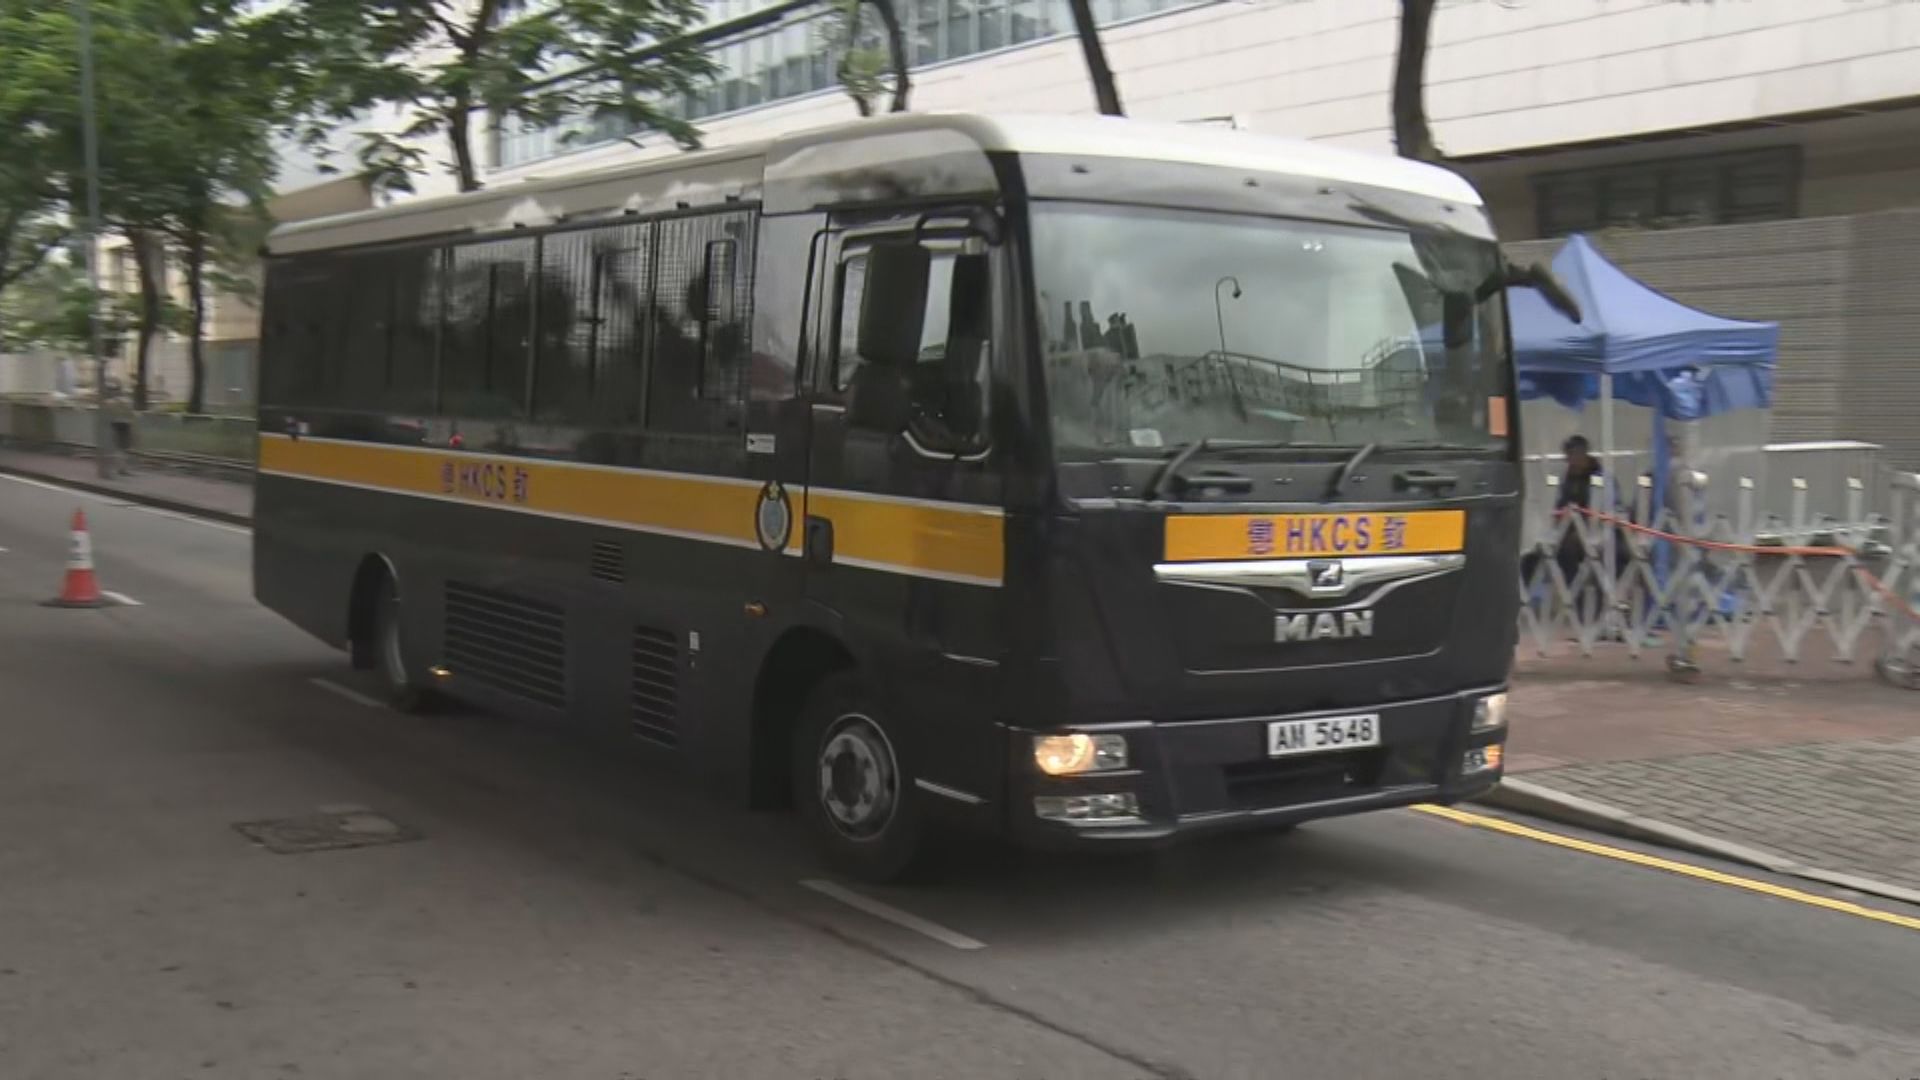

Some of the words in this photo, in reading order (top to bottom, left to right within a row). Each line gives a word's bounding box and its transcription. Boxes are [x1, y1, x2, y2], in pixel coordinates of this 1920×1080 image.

[461, 464, 507, 499] HKCS
[1286, 517, 1372, 552] HKCS
[1274, 610, 1374, 643] MAN
[1275, 724, 1307, 750] AM
[1314, 718, 1373, 746] 5648
